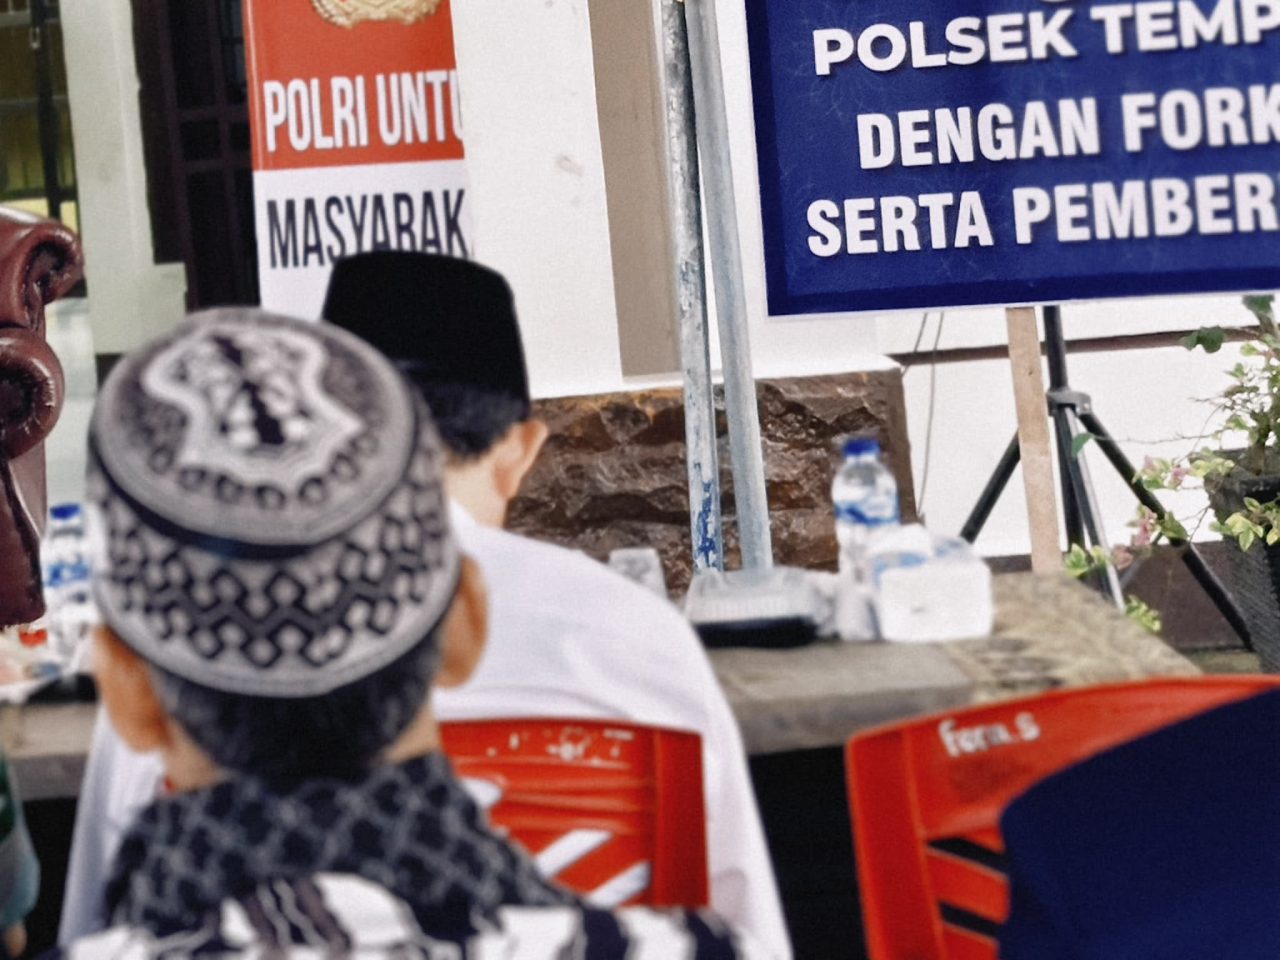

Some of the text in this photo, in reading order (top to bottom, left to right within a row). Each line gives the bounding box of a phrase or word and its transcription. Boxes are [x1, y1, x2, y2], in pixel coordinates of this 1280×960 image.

[812, 8, 1078, 76] POLSEK
[263, 74, 368, 153] POLRI
[857, 83, 1280, 170] DENGAN FORK
[806, 172, 1280, 257] SERTA PEMBER
